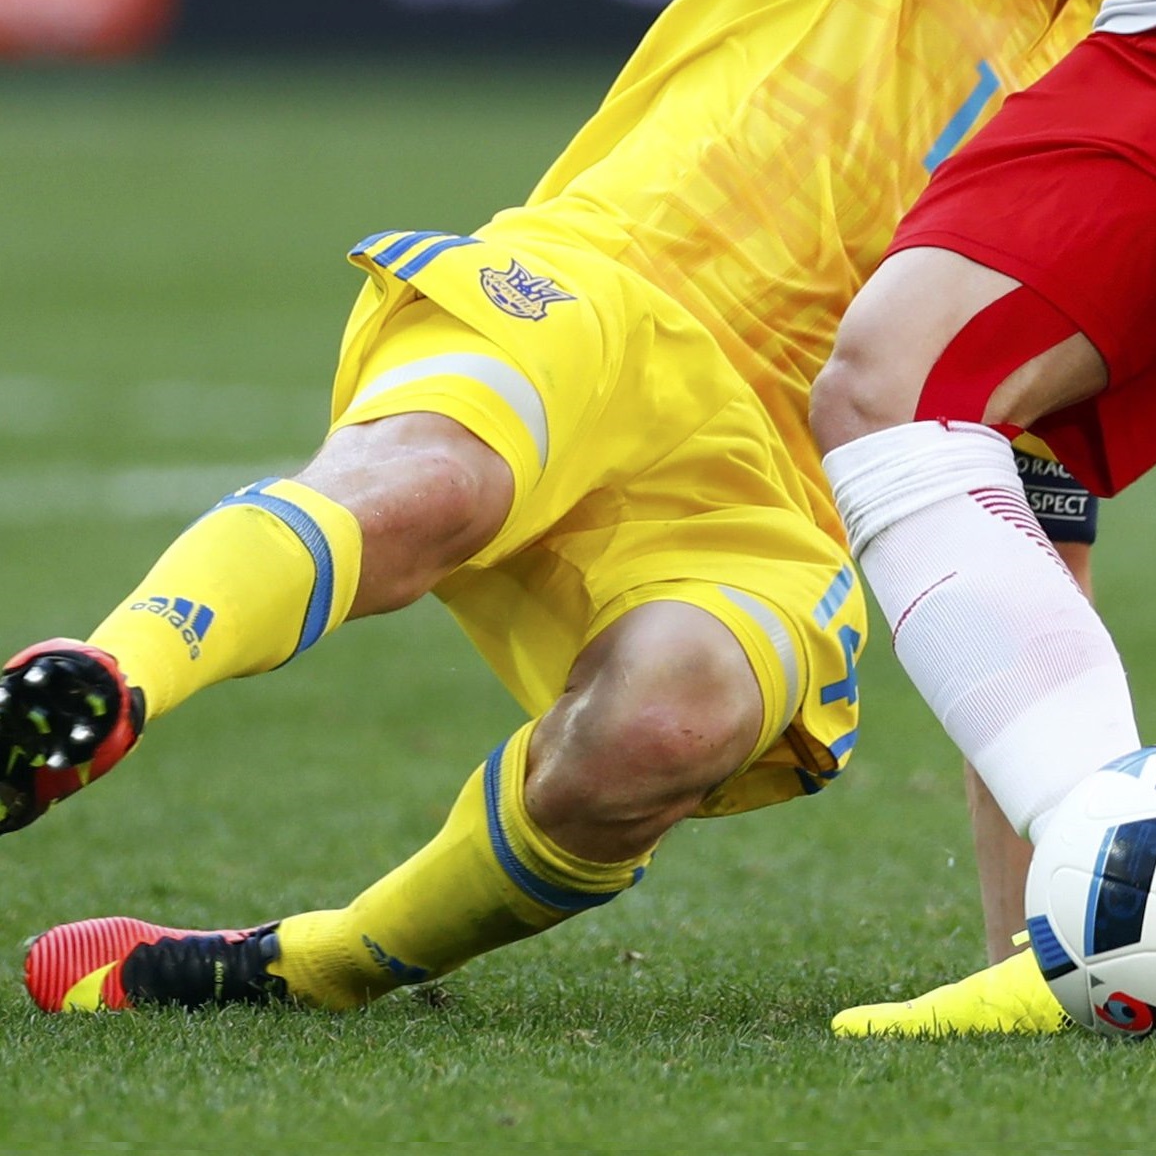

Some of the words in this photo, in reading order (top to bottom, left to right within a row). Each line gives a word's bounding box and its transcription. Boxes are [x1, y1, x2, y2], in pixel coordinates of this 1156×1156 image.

[1032, 460, 1073, 478] RAC
[1027, 492, 1088, 514] SPECT
[130, 601, 201, 662] adidas
